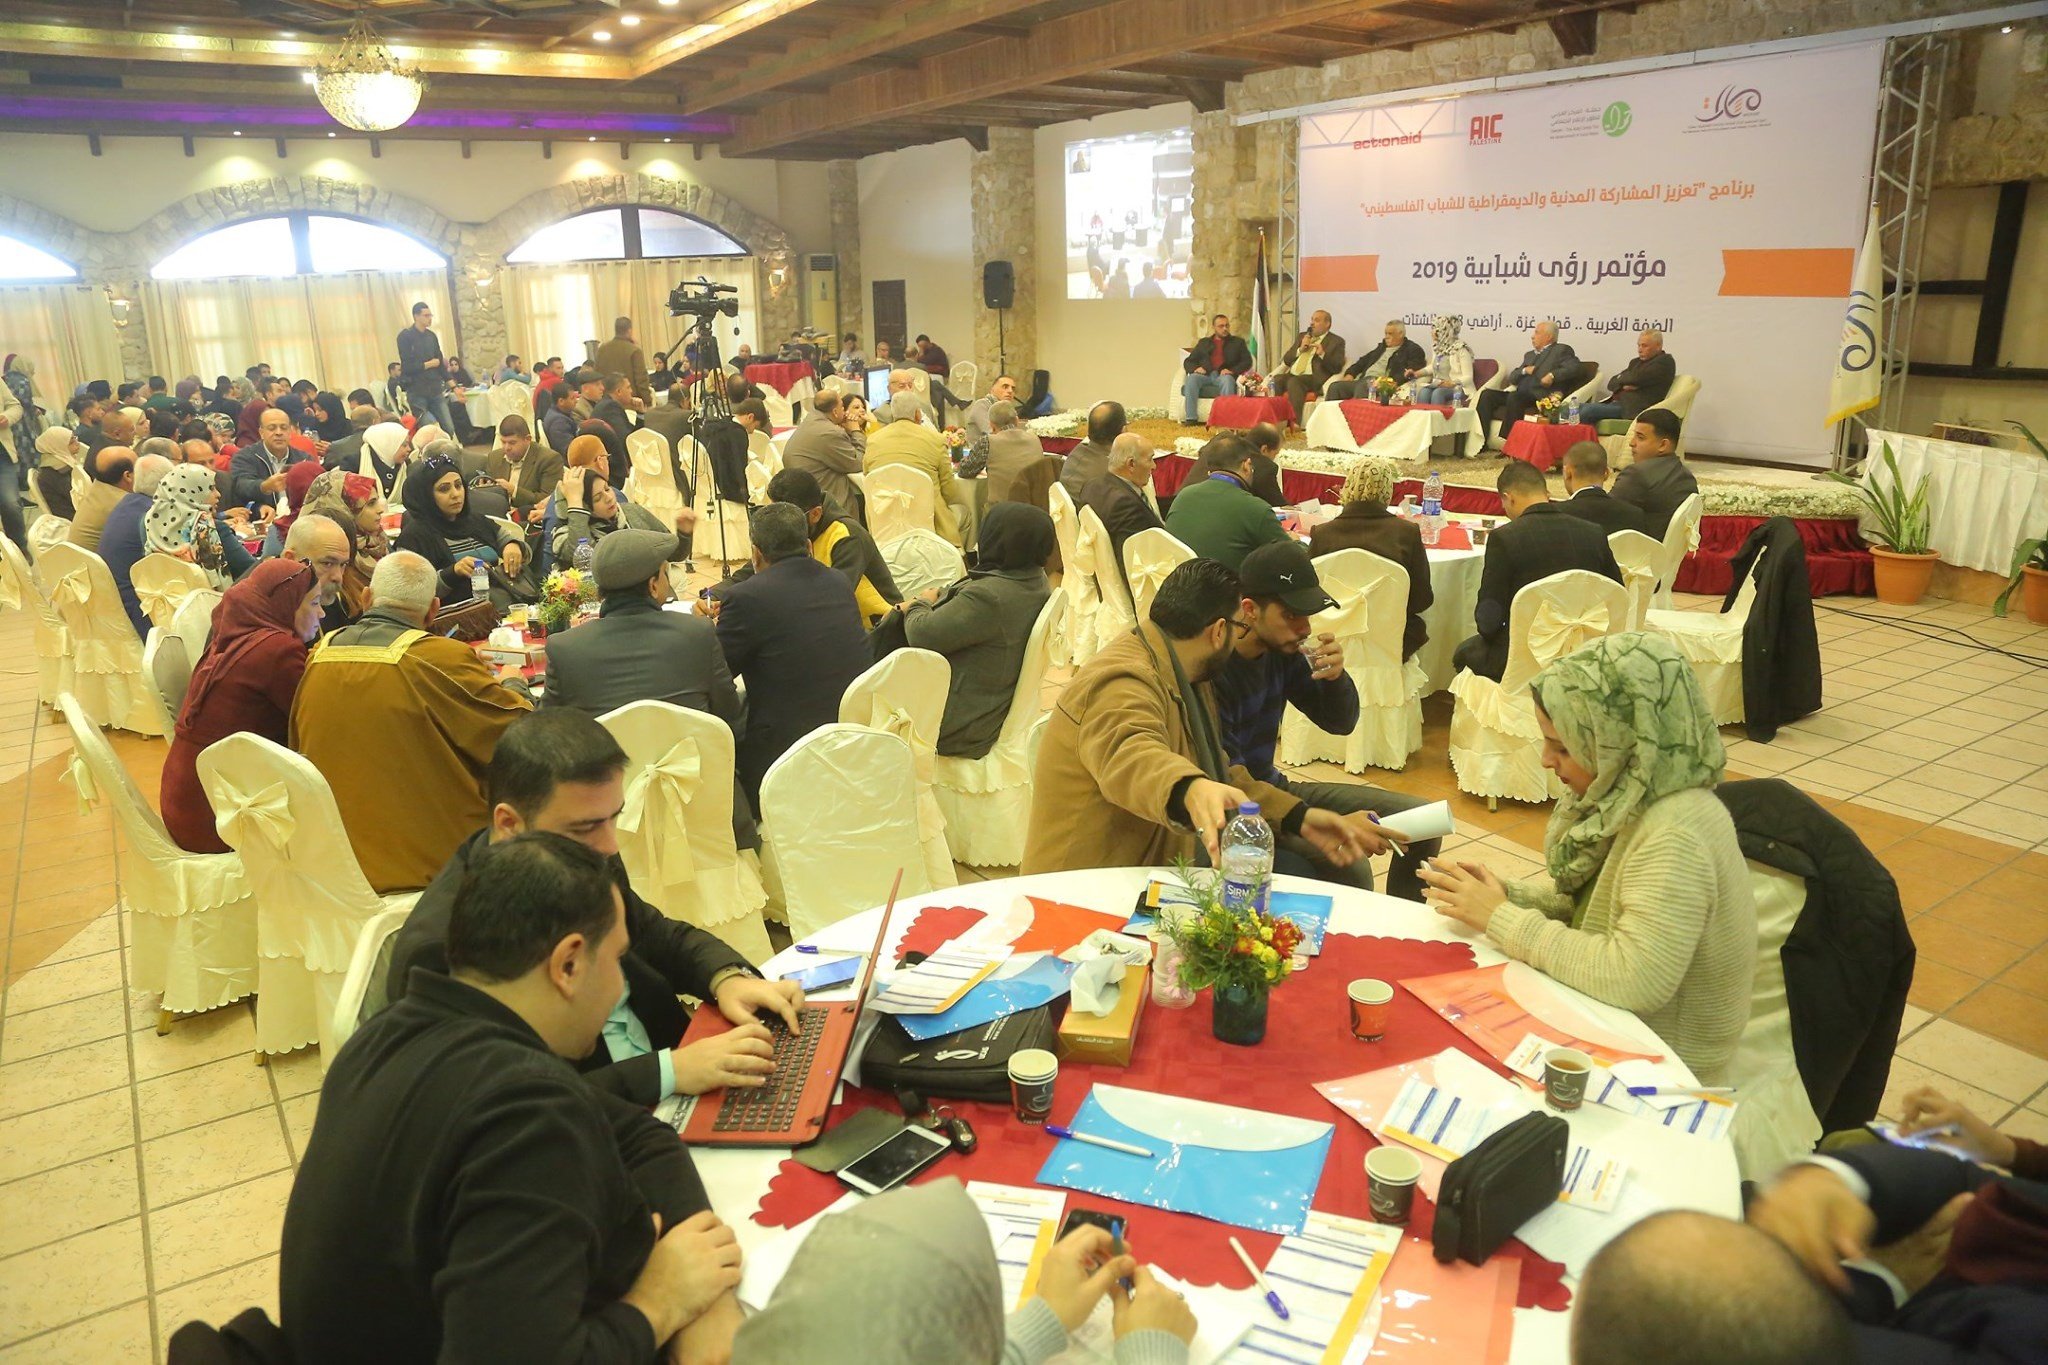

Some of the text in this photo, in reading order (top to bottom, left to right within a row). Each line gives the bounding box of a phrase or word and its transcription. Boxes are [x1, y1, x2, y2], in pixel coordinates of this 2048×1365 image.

[1469, 114, 1503, 140] AIC
[1469, 138, 1502, 146] PALESTINE
[1550, 188, 1595, 207] المدنية
[1599, 184, 1661, 205] المشاركة
[1709, 180, 1755, 200] برنامج
[1428, 196, 1465, 214] للشباب
[1468, 192, 1546, 211] والديمقراطية
[1412, 250, 1666, 285] مؤتمر رؤى شبابية 2019
[1466, 312, 1502, 331] أراضي
[1516, 315, 1536, 332] غزة
[1586, 317, 1628, 335] الغربية
[1632, 318, 1674, 333] الضفة
[1227, 884, 1253, 899] SIRM
